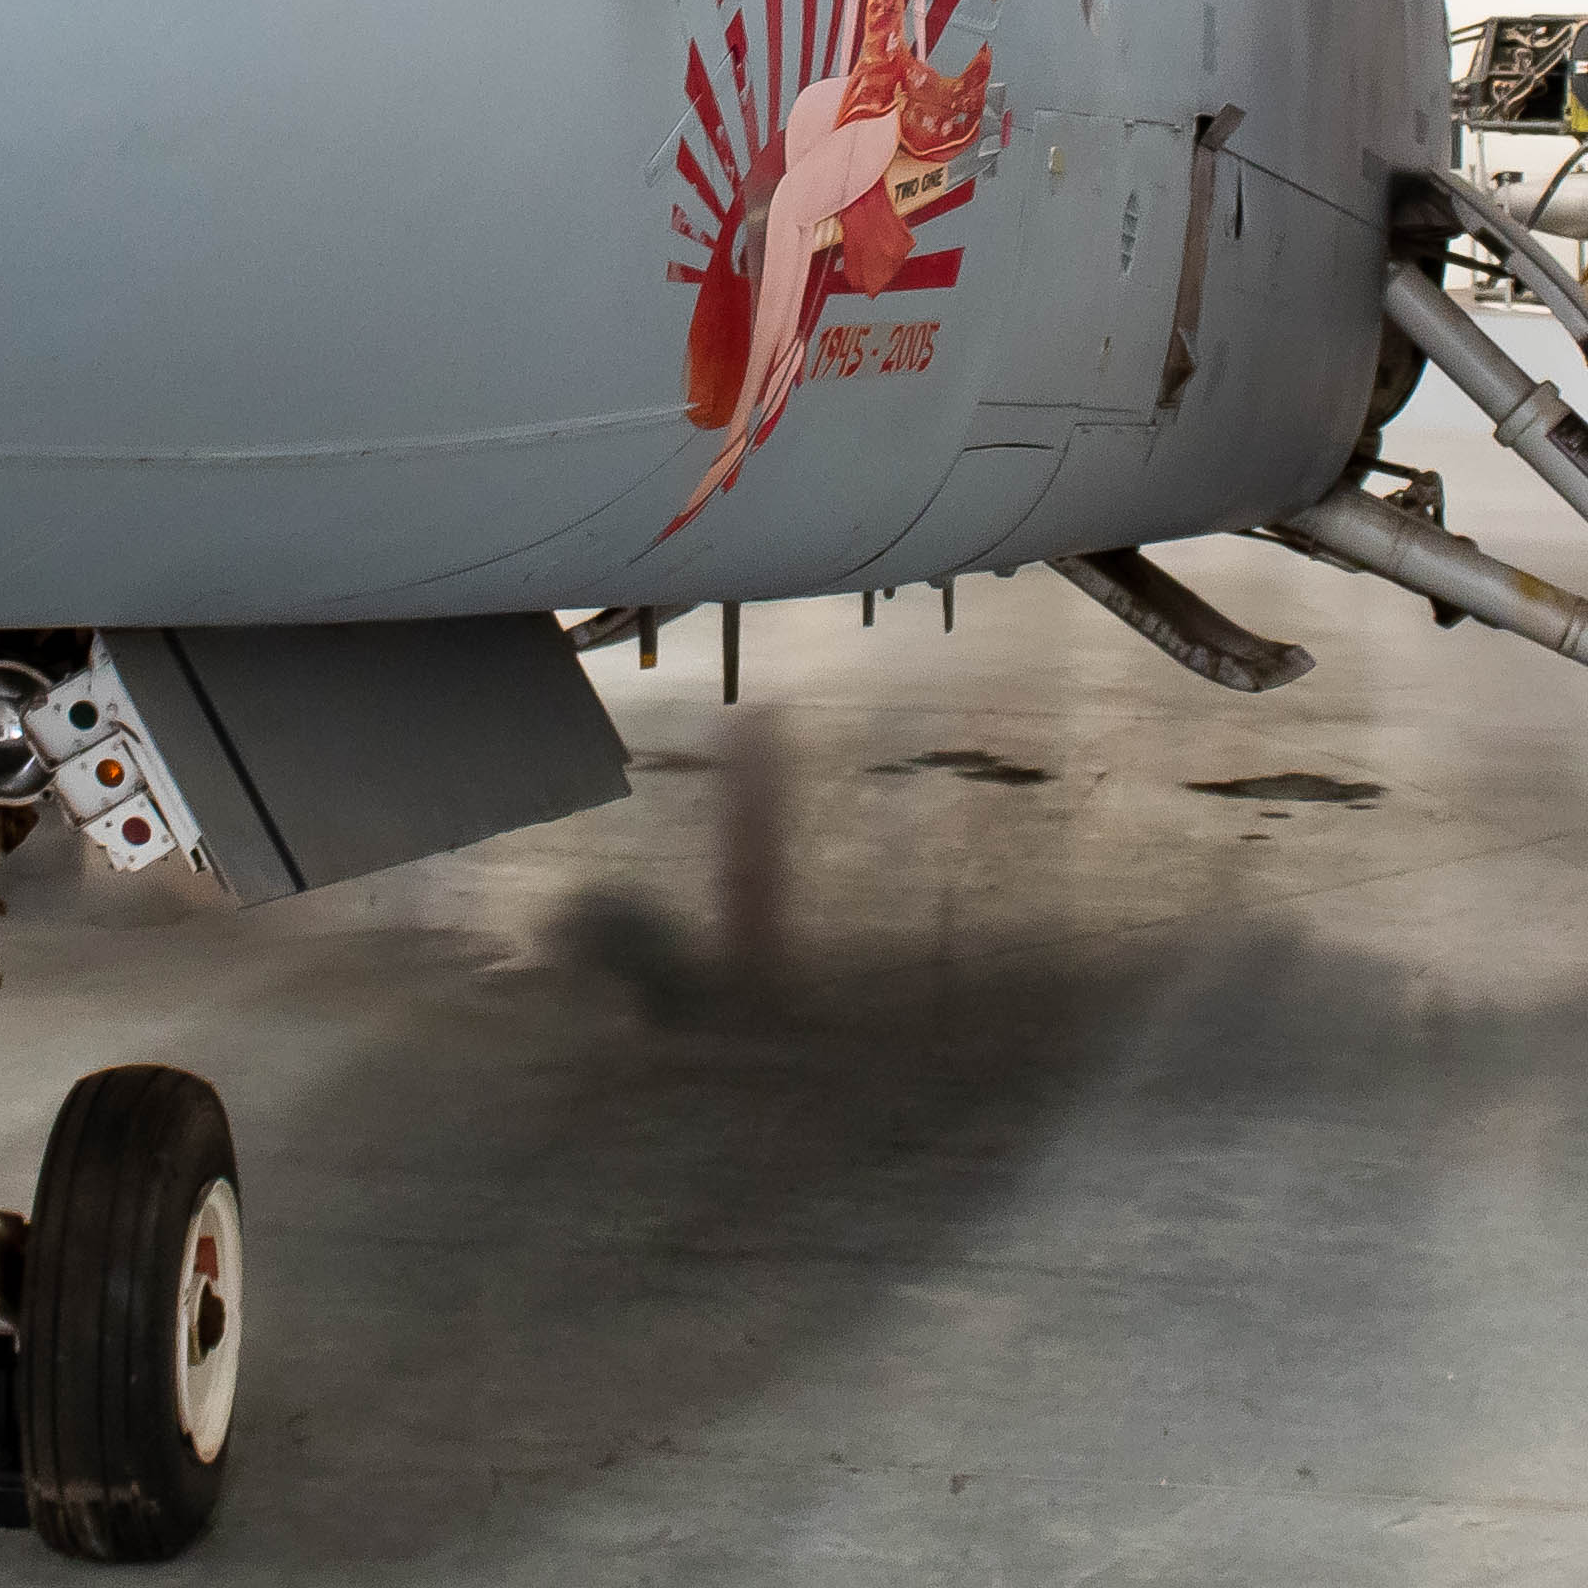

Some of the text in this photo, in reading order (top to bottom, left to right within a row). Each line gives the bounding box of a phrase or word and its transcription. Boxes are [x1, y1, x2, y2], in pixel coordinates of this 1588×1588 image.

[894, 177, 920, 204] TWO
[810, 323, 871, 381] 1945
[878, 321, 942, 374] 2005
